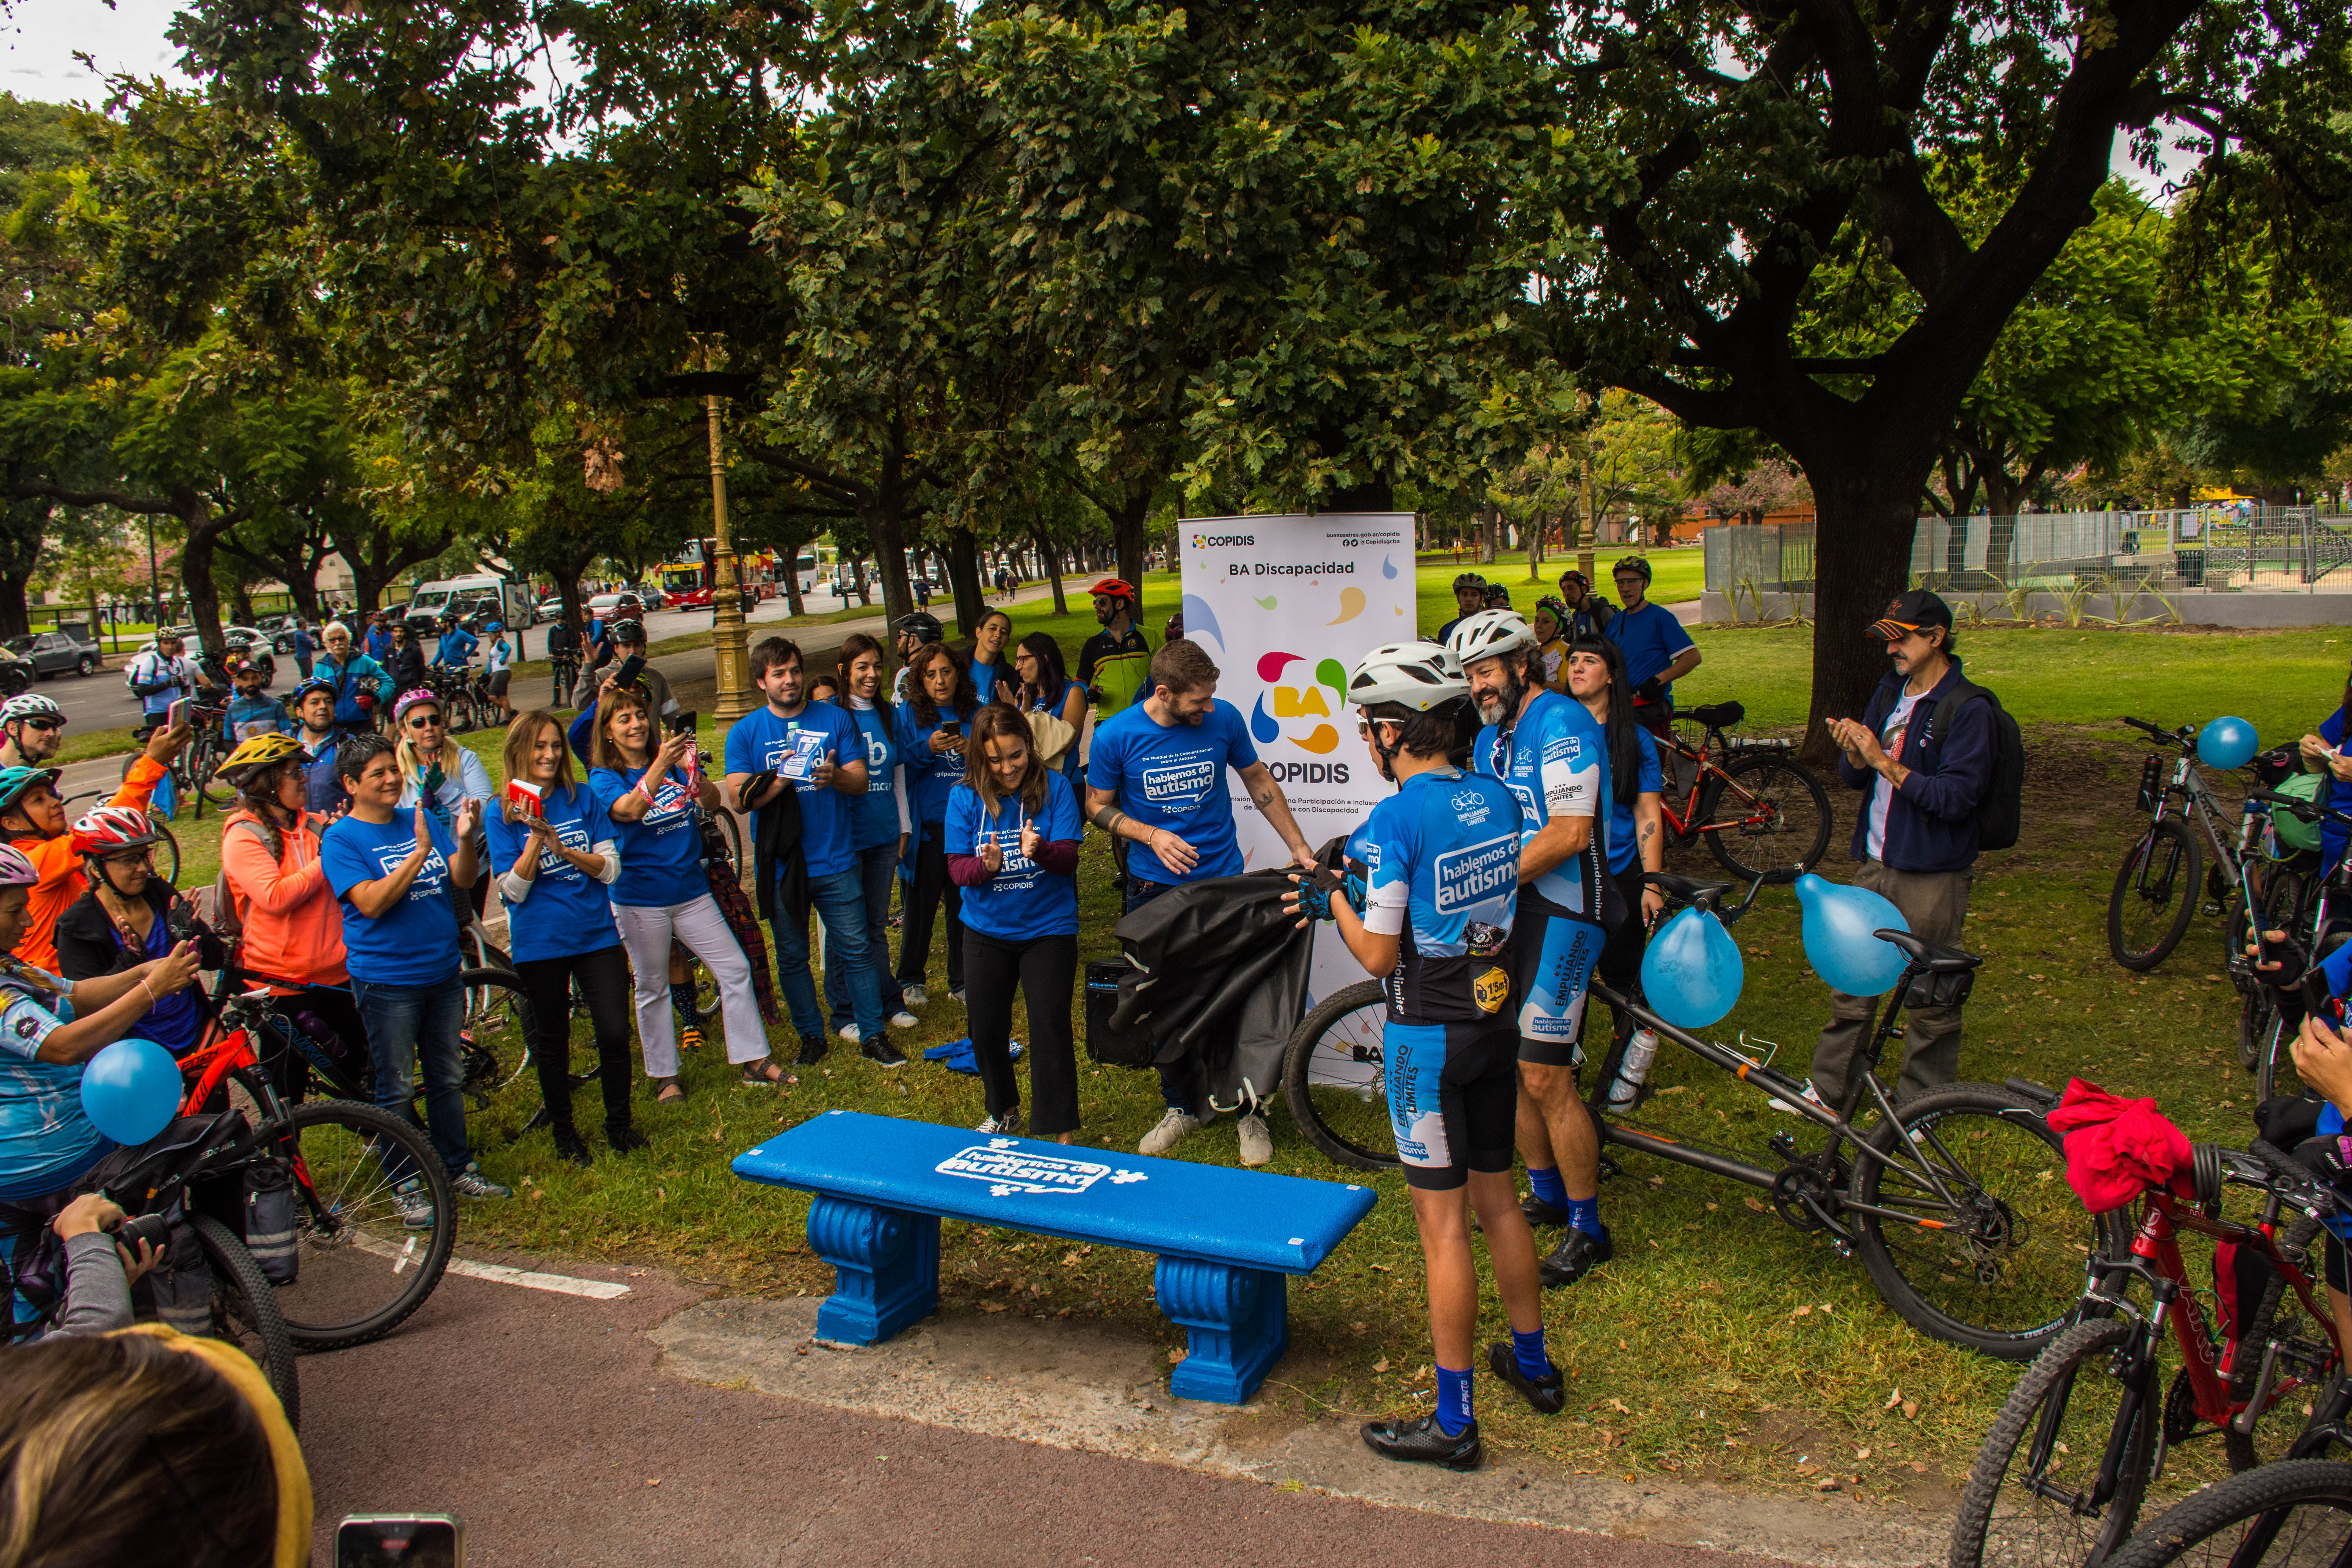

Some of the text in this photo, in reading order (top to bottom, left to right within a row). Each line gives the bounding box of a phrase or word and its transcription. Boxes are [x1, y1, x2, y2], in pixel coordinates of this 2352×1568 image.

[1208, 535, 1254, 546] COPIDIS
[1229, 562, 1354, 577] BA Discapacidad
[1274, 686, 1330, 718] BA
[1543, 745, 1579, 763] autismo
[1544, 740, 1569, 755] hablemos
[1148, 764, 1210, 784] hablemos de
[1147, 775, 1213, 796] autismo
[1515, 789, 1528, 802] de
[1172, 804, 1201, 813] COPIDIS
[1457, 806, 1490, 820] EMPUJANDO
[664, 820, 690, 832] COPIDIS
[1466, 816, 1486, 827] LIMITES
[574, 833, 584, 842] de
[1443, 837, 1519, 882] hablemos de
[1003, 882, 1033, 890] COPIDIS
[1439, 857, 1519, 906] autismo
[418, 887, 443, 898] COPIDIS
[1554, 929, 1585, 1007] EMPUJANDO
[1572, 948, 1589, 992] LIMITES
[272, 1015, 332, 1069] VAIRO
[181, 1047, 219, 1070] PITCH
[1394, 1044, 1408, 1128] EMPUJANDO
[1405, 1066, 1418, 1113] LIMITES
[1397, 1143, 1428, 1155] utismo
[965, 1151, 1068, 1172] hablemos
[2325, 1152, 2343, 1170] GIANT
[953, 1159, 1094, 1188] autismo
[2139, 1224, 2157, 1236] AIRO
